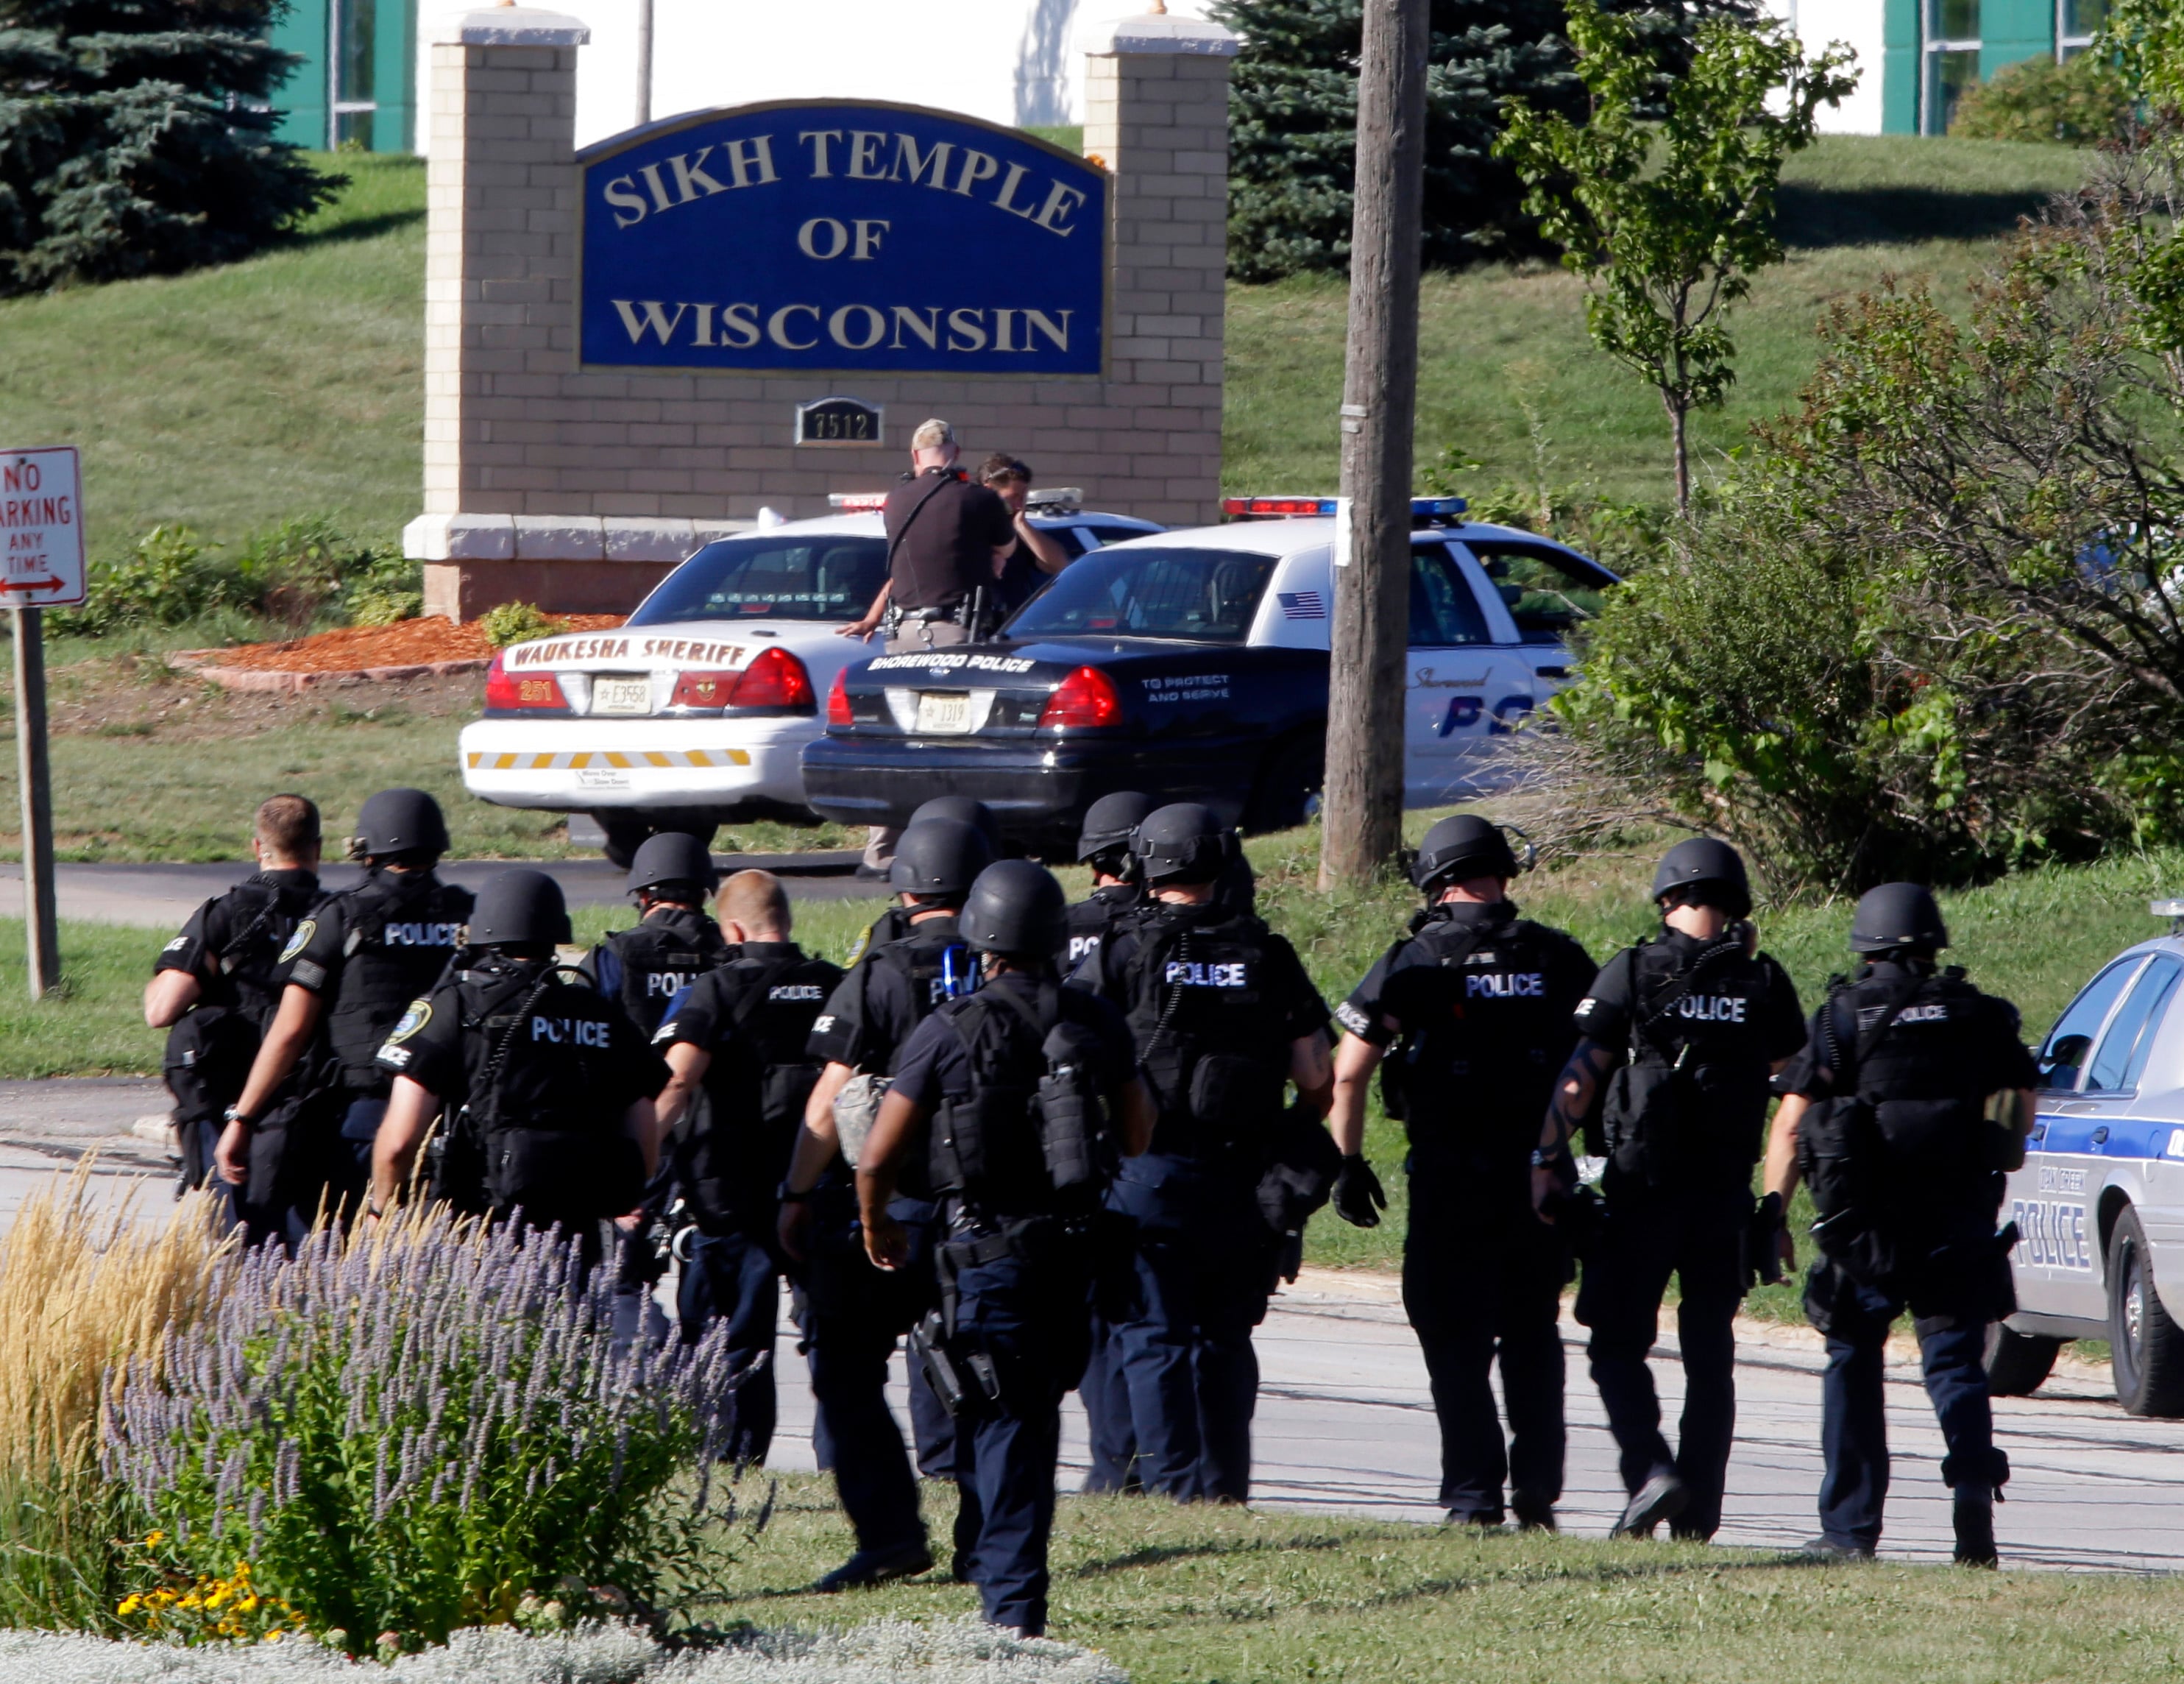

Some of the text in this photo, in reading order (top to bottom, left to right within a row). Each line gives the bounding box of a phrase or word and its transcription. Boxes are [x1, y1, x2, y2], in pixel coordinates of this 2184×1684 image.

[603, 129, 1086, 238] SIKH TEMPLE
[797, 217, 890, 261] OF
[611, 299, 1074, 353] WISCONSIN
[815, 413, 867, 439] 7512
[4, 464, 40, 492] NO
[9, 533, 43, 551] ANY
[7, 554, 49, 574] TIME
[514, 639, 747, 665] WAUKESHA SHERIFF
[867, 654, 1036, 673] SHOREWOOD POLICE
[520, 679, 552, 701] 251
[1141, 678, 1162, 690] TO
[1149, 692, 1180, 701] AND
[385, 922, 461, 946] POLICE
[1166, 961, 1246, 987] POLICE
[1465, 972, 1543, 998] POLICE
[769, 985, 823, 1000] POLICE
[1664, 994, 1747, 1023] OLICE
[2012, 1197, 2093, 1273] POLICE
